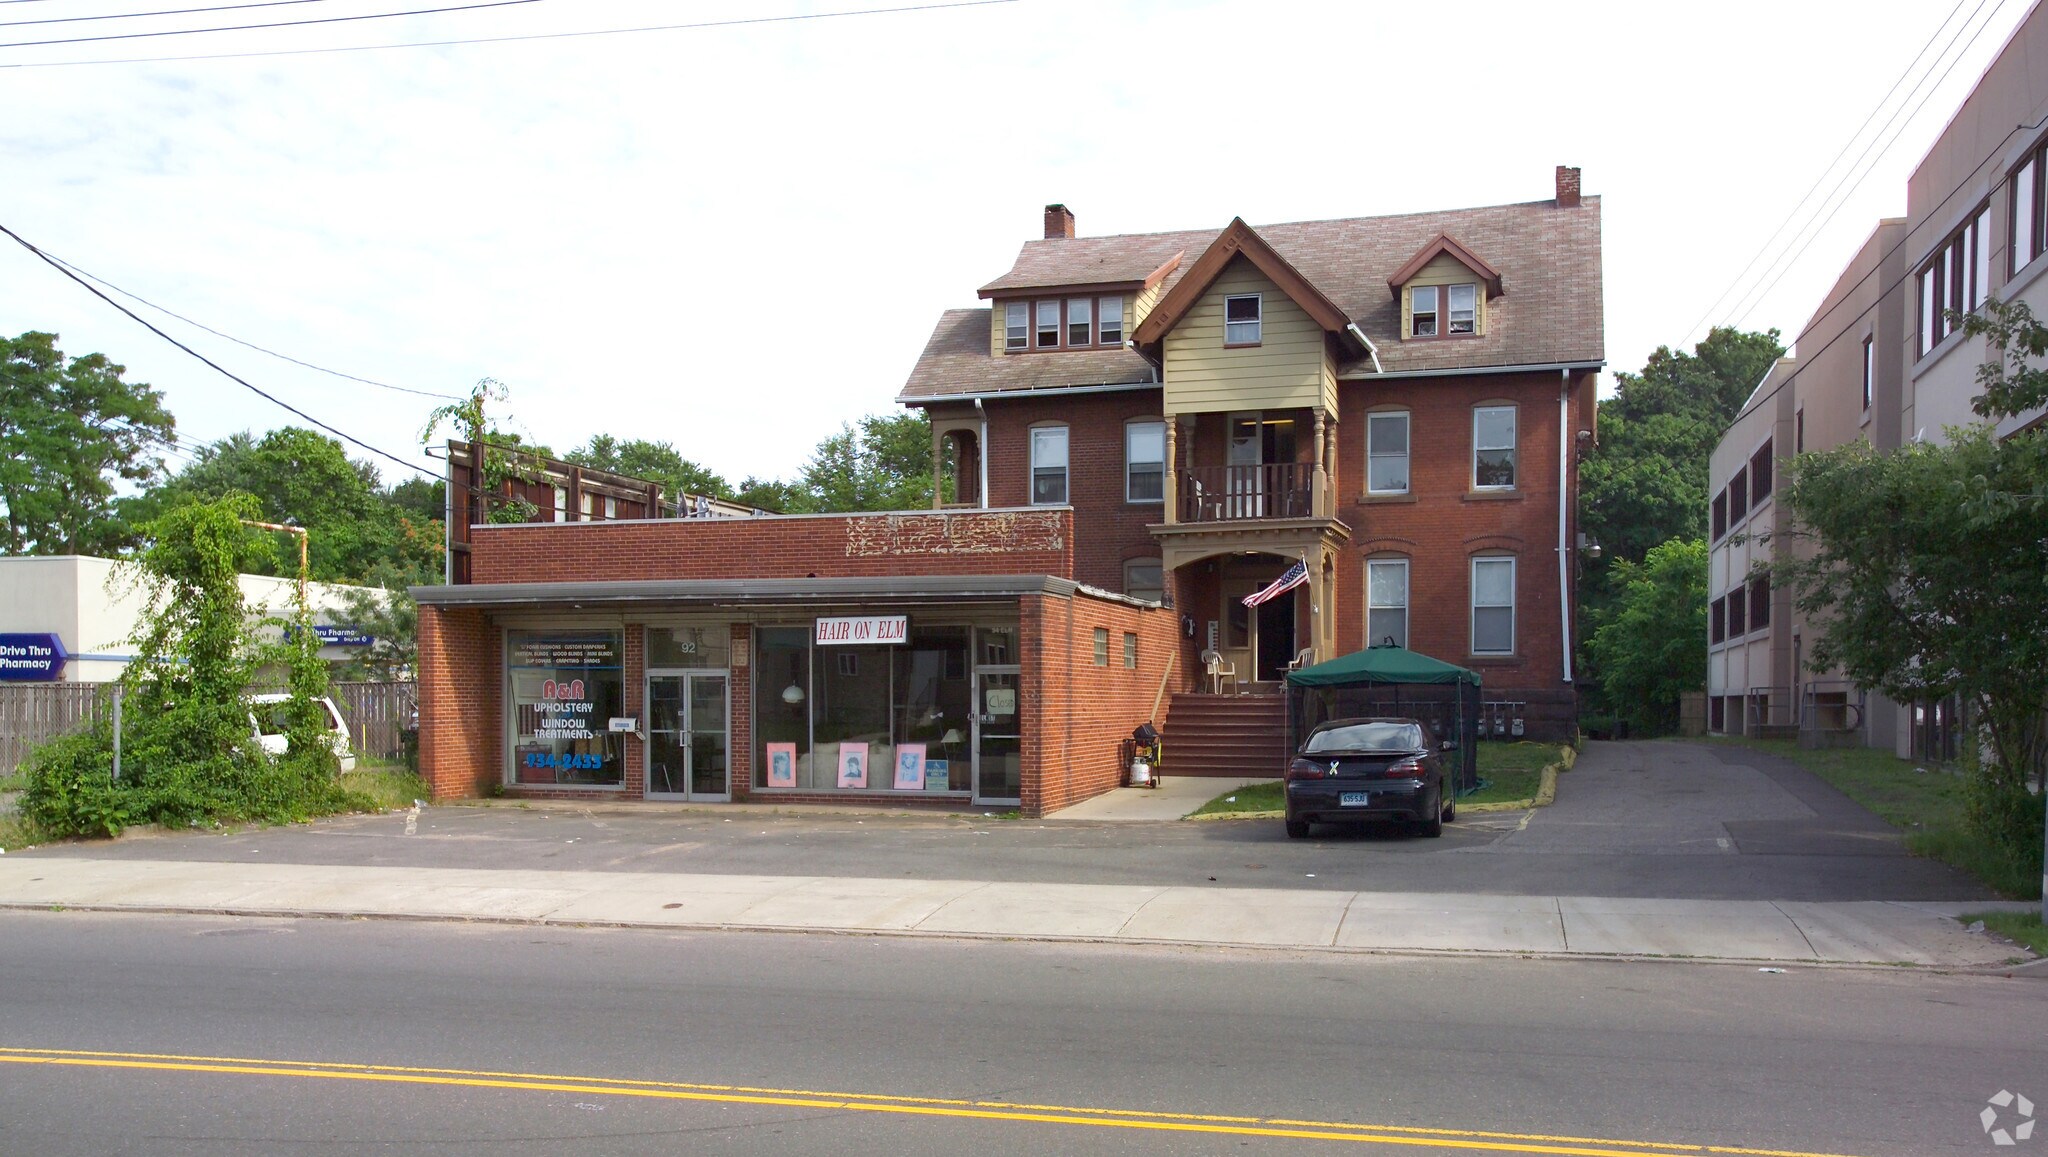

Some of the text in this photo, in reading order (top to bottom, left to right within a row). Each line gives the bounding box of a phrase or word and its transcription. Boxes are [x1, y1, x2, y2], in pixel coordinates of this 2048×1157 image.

[817, 620, 905, 640] HAIR ON ELM
[0, 645, 51, 656] Drive Thru
[0, 658, 51, 670] Pharmacy
[542, 679, 585, 700] A&R
[534, 702, 593, 713] UPHOLSTERY
[542, 719, 586, 729] WINDOW
[533, 729, 594, 739] TREATMENTS
